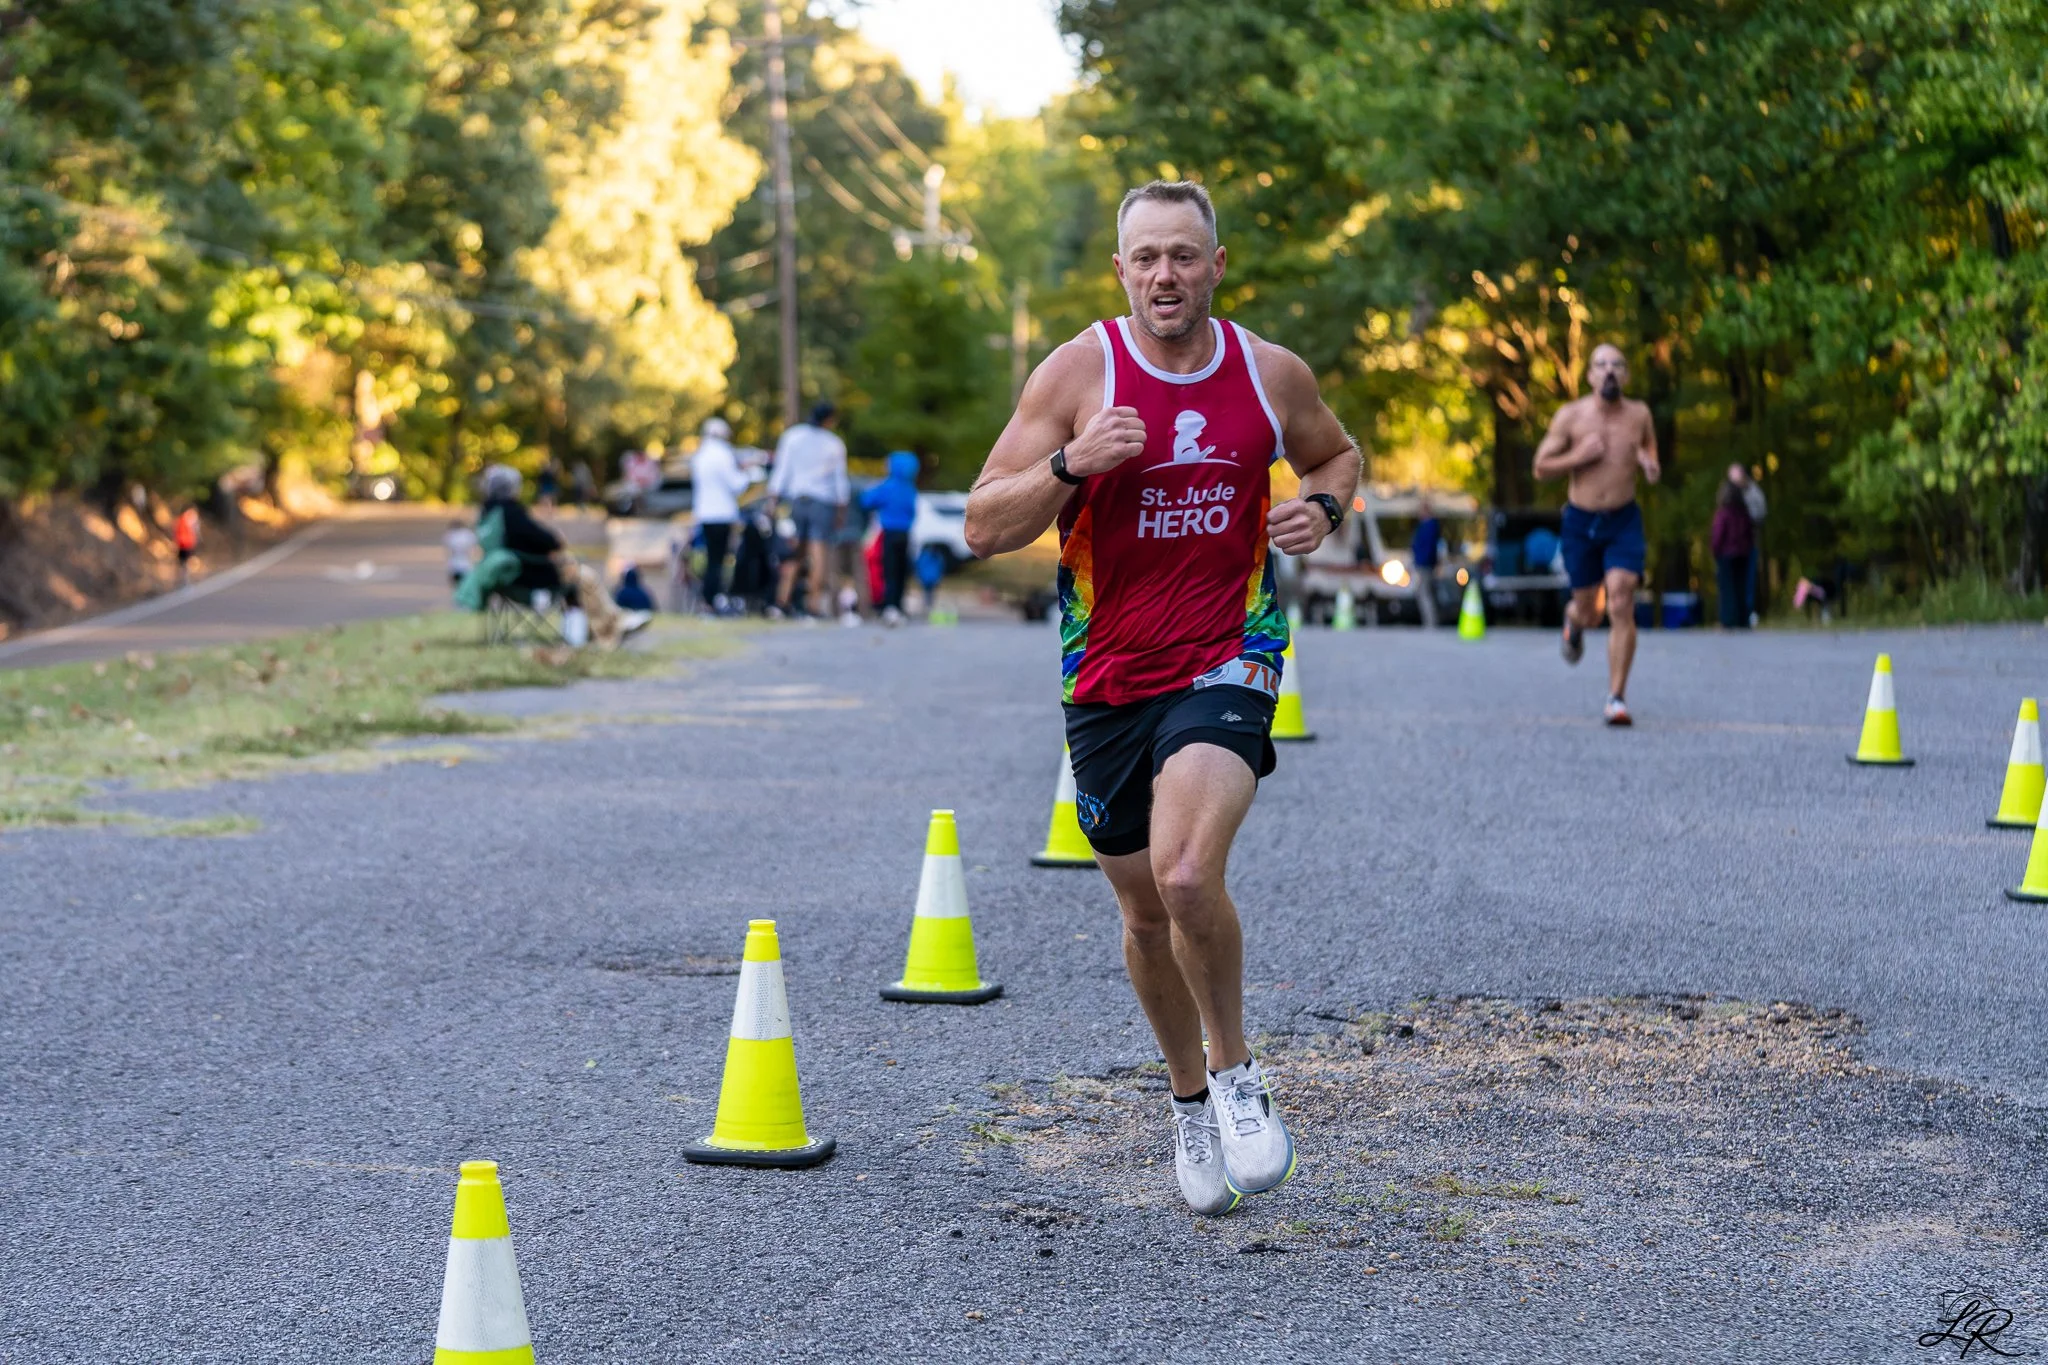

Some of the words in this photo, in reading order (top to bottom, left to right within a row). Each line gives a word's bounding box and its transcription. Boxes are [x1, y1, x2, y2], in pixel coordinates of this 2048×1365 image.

[1140, 487, 1173, 507] St.
[1177, 482, 1235, 506] Jude
[1137, 505, 1230, 539] HERO
